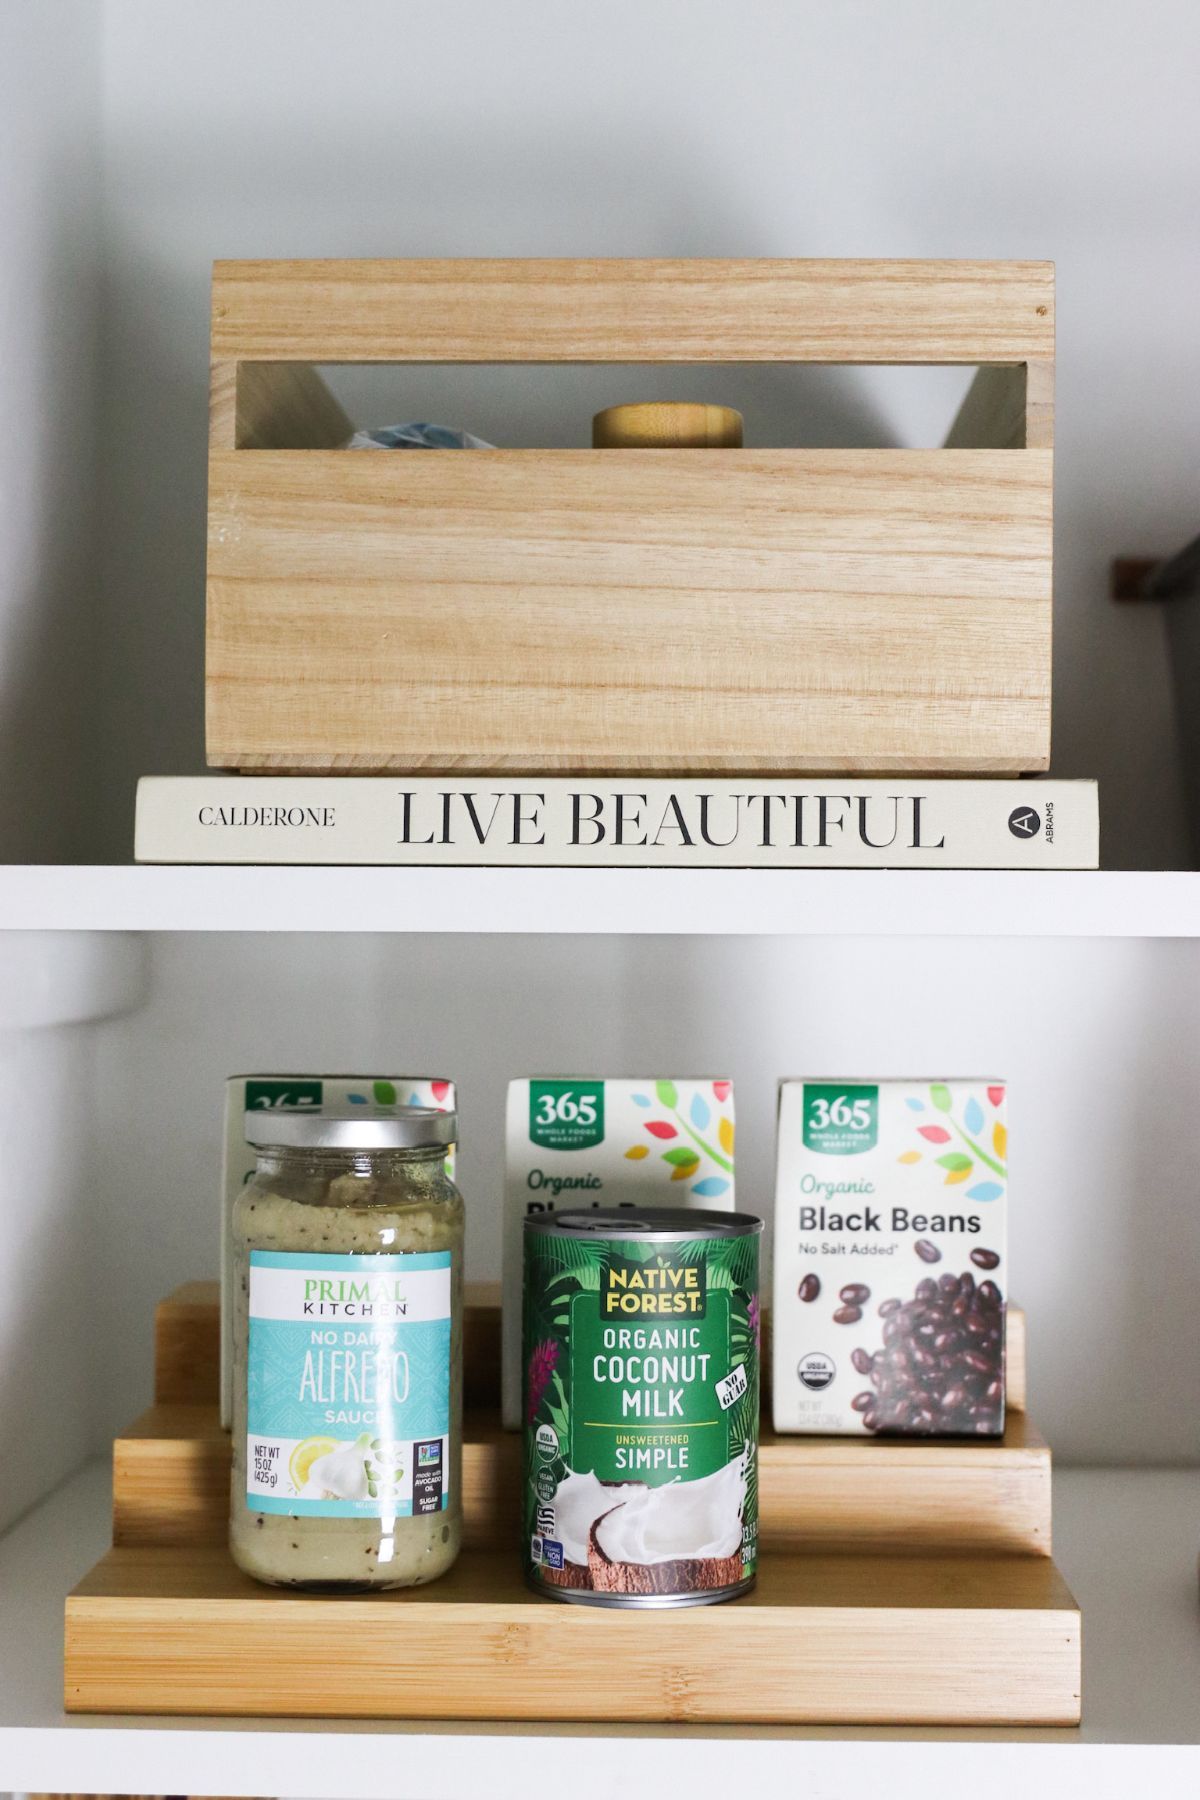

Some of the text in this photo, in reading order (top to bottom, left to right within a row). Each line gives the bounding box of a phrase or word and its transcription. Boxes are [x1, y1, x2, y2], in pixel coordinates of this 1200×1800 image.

[199, 806, 336, 827] CALDERONE
[397, 792, 945, 849] LIVE BEAUTIFUL
[1045, 802, 1054, 844] ABRAMS
[535, 1092, 597, 1126] 365
[808, 1095, 872, 1131] 365
[527, 1169, 603, 1195] Organic
[800, 1173, 876, 1200] Organic
[799, 1206, 981, 1233] Black Beans
[799, 1242, 818, 1255] No
[821, 1243, 846, 1256] Salt
[609, 1266, 698, 1289] NATIVE
[303, 1279, 407, 1302] PRIMAL
[303, 1302, 407, 1316] KITCHEN
[311, 1330, 337, 1345] NO
[603, 1328, 700, 1350] ORGANIC
[298, 1349, 410, 1404] ALFREO
[593, 1354, 711, 1383] COCONUT
[722, 1378, 746, 1406] GUAR
[725, 1373, 738, 1391] NO
[622, 1388, 684, 1417] MILK
[324, 1409, 388, 1424] SAUC
[540, 1431, 554, 1443] USDA
[616, 1434, 689, 1445] UNSWEETENED
[254, 1445, 280, 1459] NET WT
[615, 1447, 689, 1469] SIMPLE
[254, 1470, 269, 1484] (425
[415, 1476, 442, 1487] AVOCADO
[419, 1496, 439, 1505] SUGAR
[421, 1504, 436, 1512] FREE
[547, 1551, 561, 1561] NON
